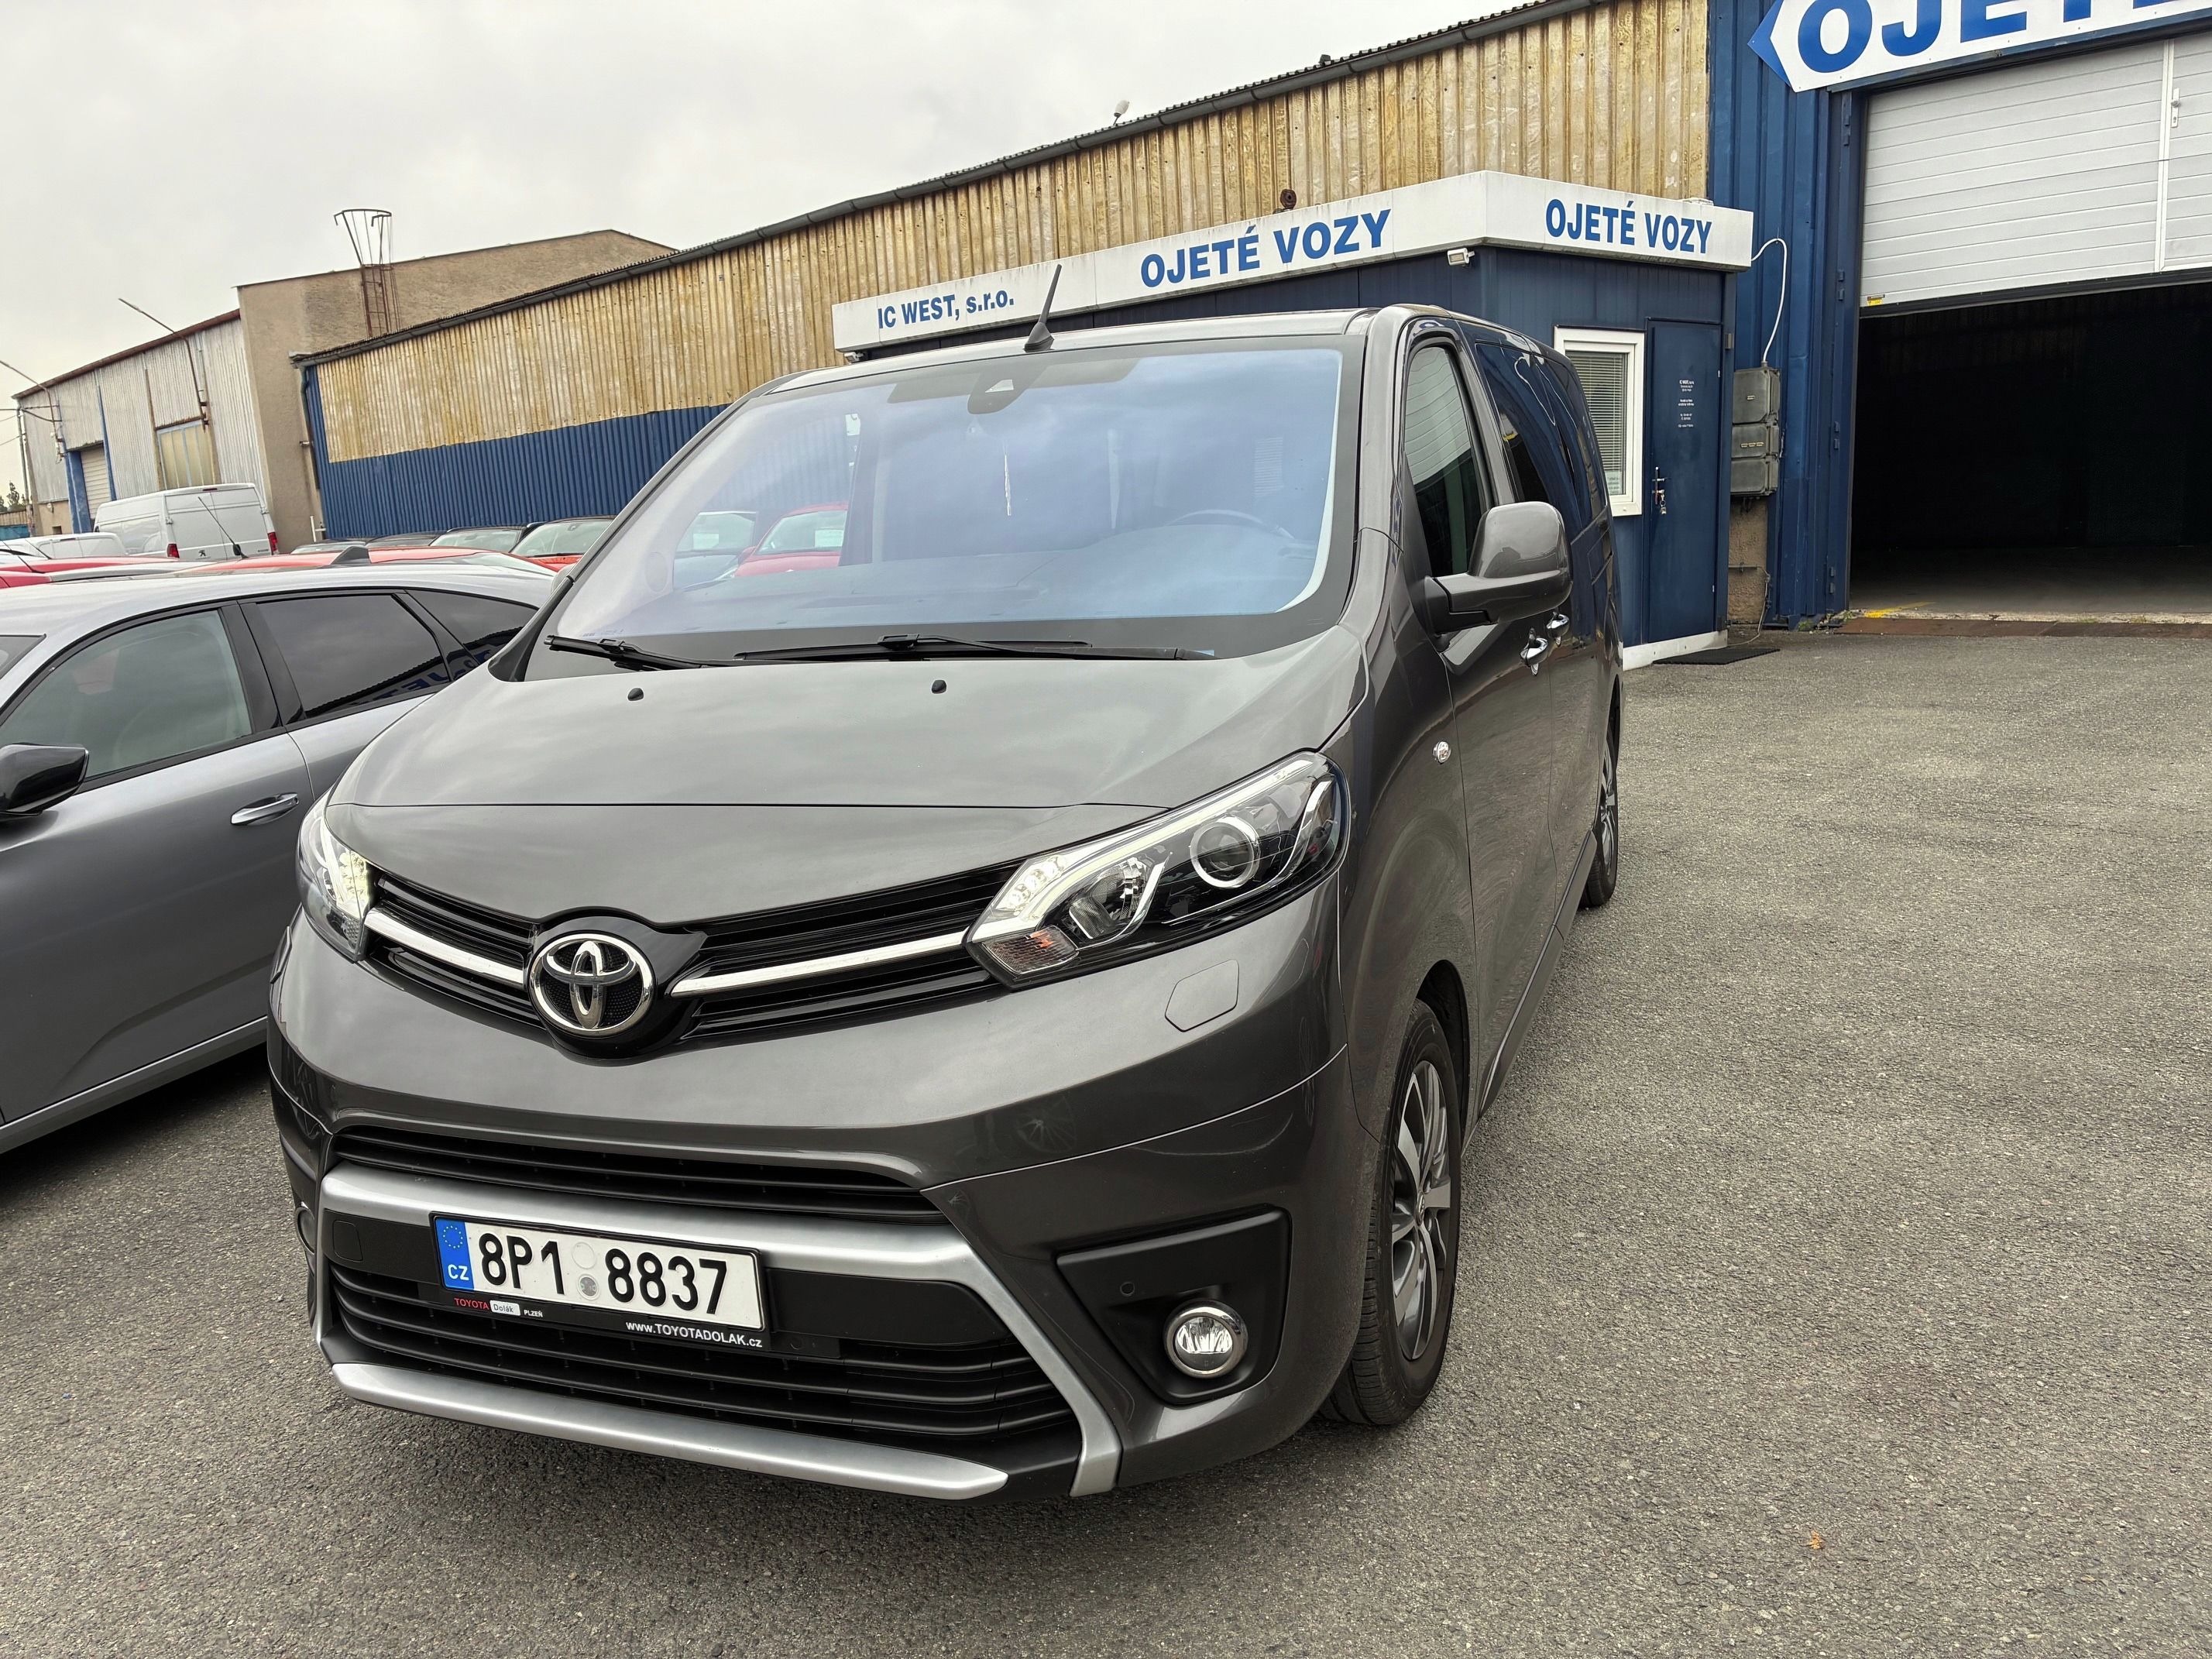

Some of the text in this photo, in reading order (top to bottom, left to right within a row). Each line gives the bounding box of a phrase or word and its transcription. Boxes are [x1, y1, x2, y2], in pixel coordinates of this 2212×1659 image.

[1798, 0, 2176, 74] OJE
[1141, 208, 1391, 287] OJETÉ VOZY
[1545, 199, 1712, 254] OJETÉ VOZY
[878, 290, 1015, 329] IC WEST, s.r.o.
[448, 1264, 469, 1281] CZ
[479, 1232, 727, 1315] 8P1 8837
[454, 1297, 489, 1310] TOYOTA
[493, 1303, 514, 1313] Dolák
[625, 1321, 763, 1348] www.TOYOTADOLAK.cz
